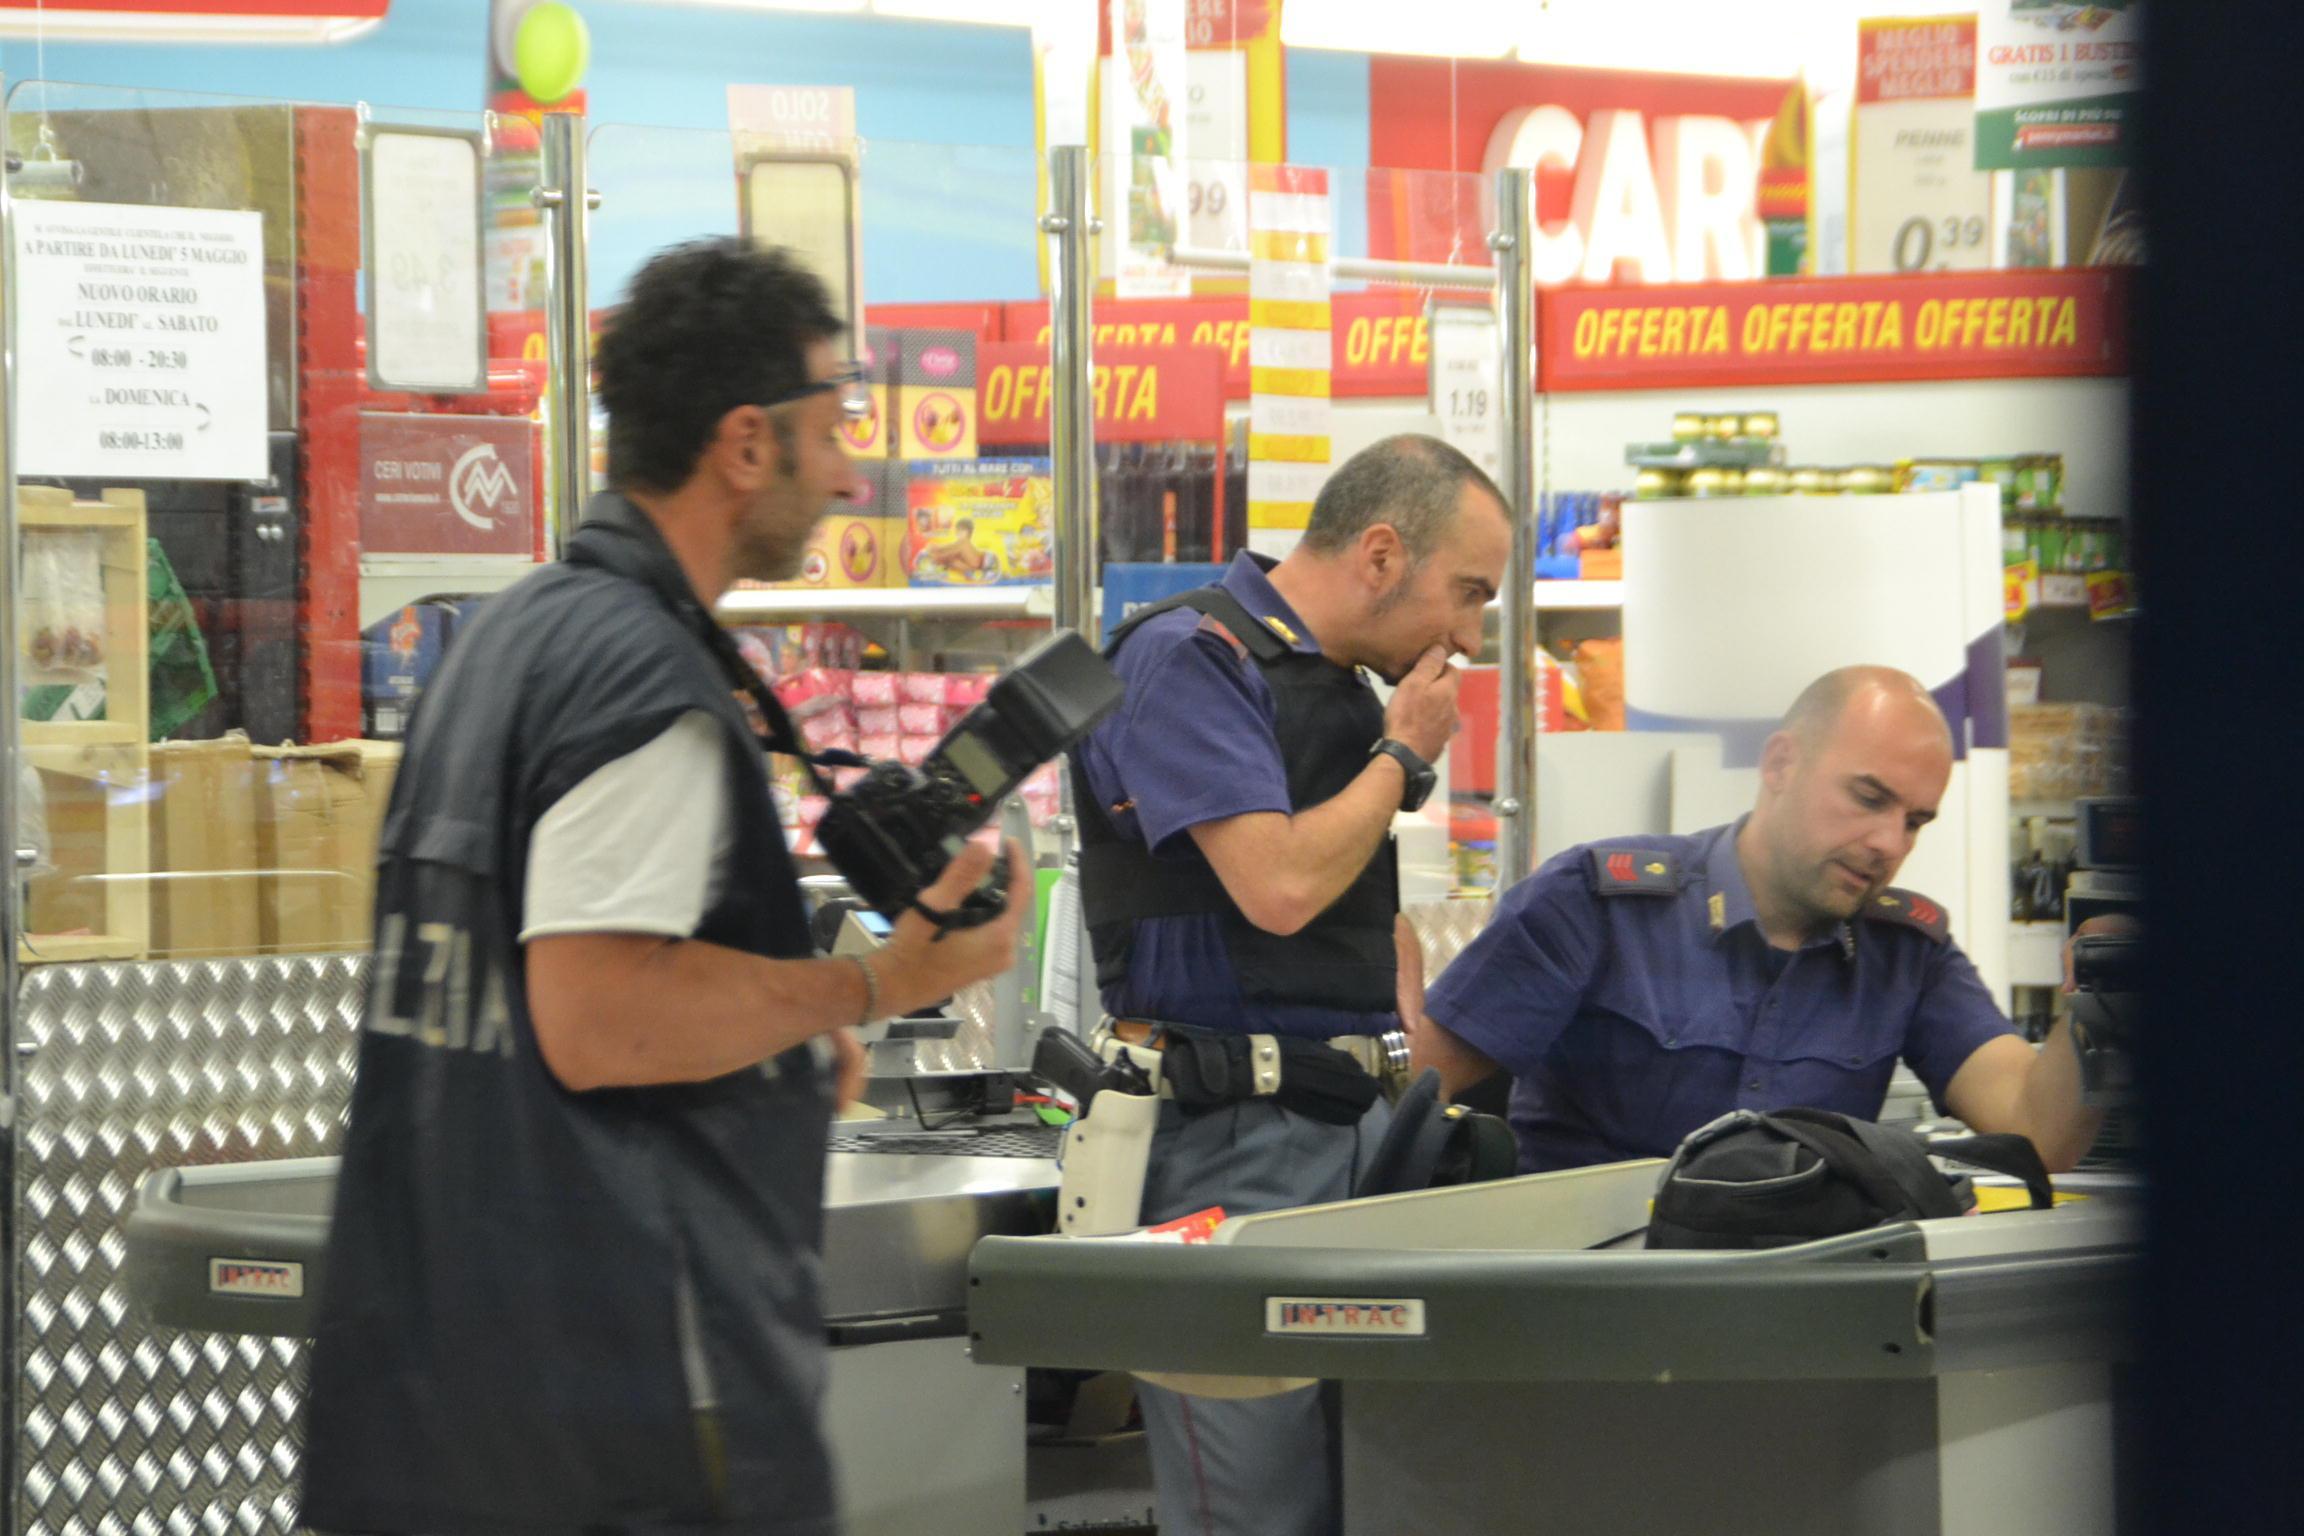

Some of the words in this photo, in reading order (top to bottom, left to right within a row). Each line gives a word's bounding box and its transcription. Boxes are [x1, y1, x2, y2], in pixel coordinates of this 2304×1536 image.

[1988, 45, 2055, 65] GRATIS
[1895, 129, 1966, 147] PENNE
[1484, 102, 1772, 285] CAR
[25, 240, 33, 254] A
[37, 240, 95, 257] PARTIRE
[100, 243, 119, 258] DA
[180, 246, 188, 261] 5
[191, 247, 247, 264] MAGGIO
[78, 282, 133, 301] NUOVO
[137, 285, 198, 304] ORARIO
[158, 314, 218, 332] SABATO
[1574, 308, 1728, 359] OFFERTA
[1742, 302, 1902, 353] OFFERTA
[1915, 297, 2078, 349] OFFERTA
[1345, 315, 1429, 366] OFFE
[92, 349, 132, 367] 08:00
[148, 350, 187, 369] 20:30
[104, 388, 190, 406] DOMENICA
[984, 364, 1158, 421] OFFRTA
[1450, 389, 1488, 417] 1.19
[99, 431, 184, 450] 08:00-13:00
[374, 460, 402, 480] CERI
[1281, 1303, 1408, 1328] INTRAC
